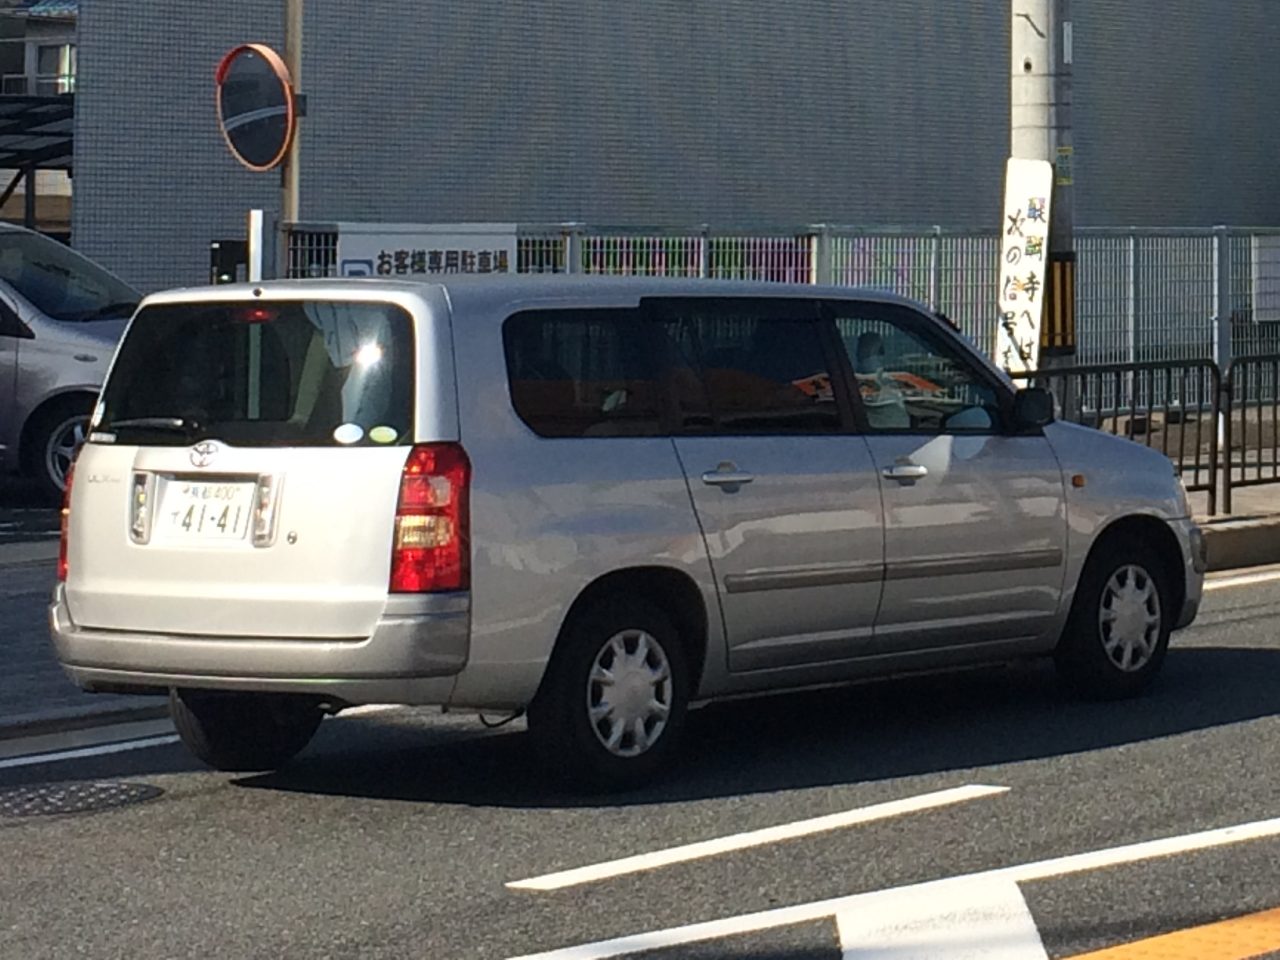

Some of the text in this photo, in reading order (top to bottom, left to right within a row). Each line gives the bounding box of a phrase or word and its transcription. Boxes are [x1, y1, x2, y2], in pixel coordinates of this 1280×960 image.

[376, 249, 509, 275] お客様専用駐車場
